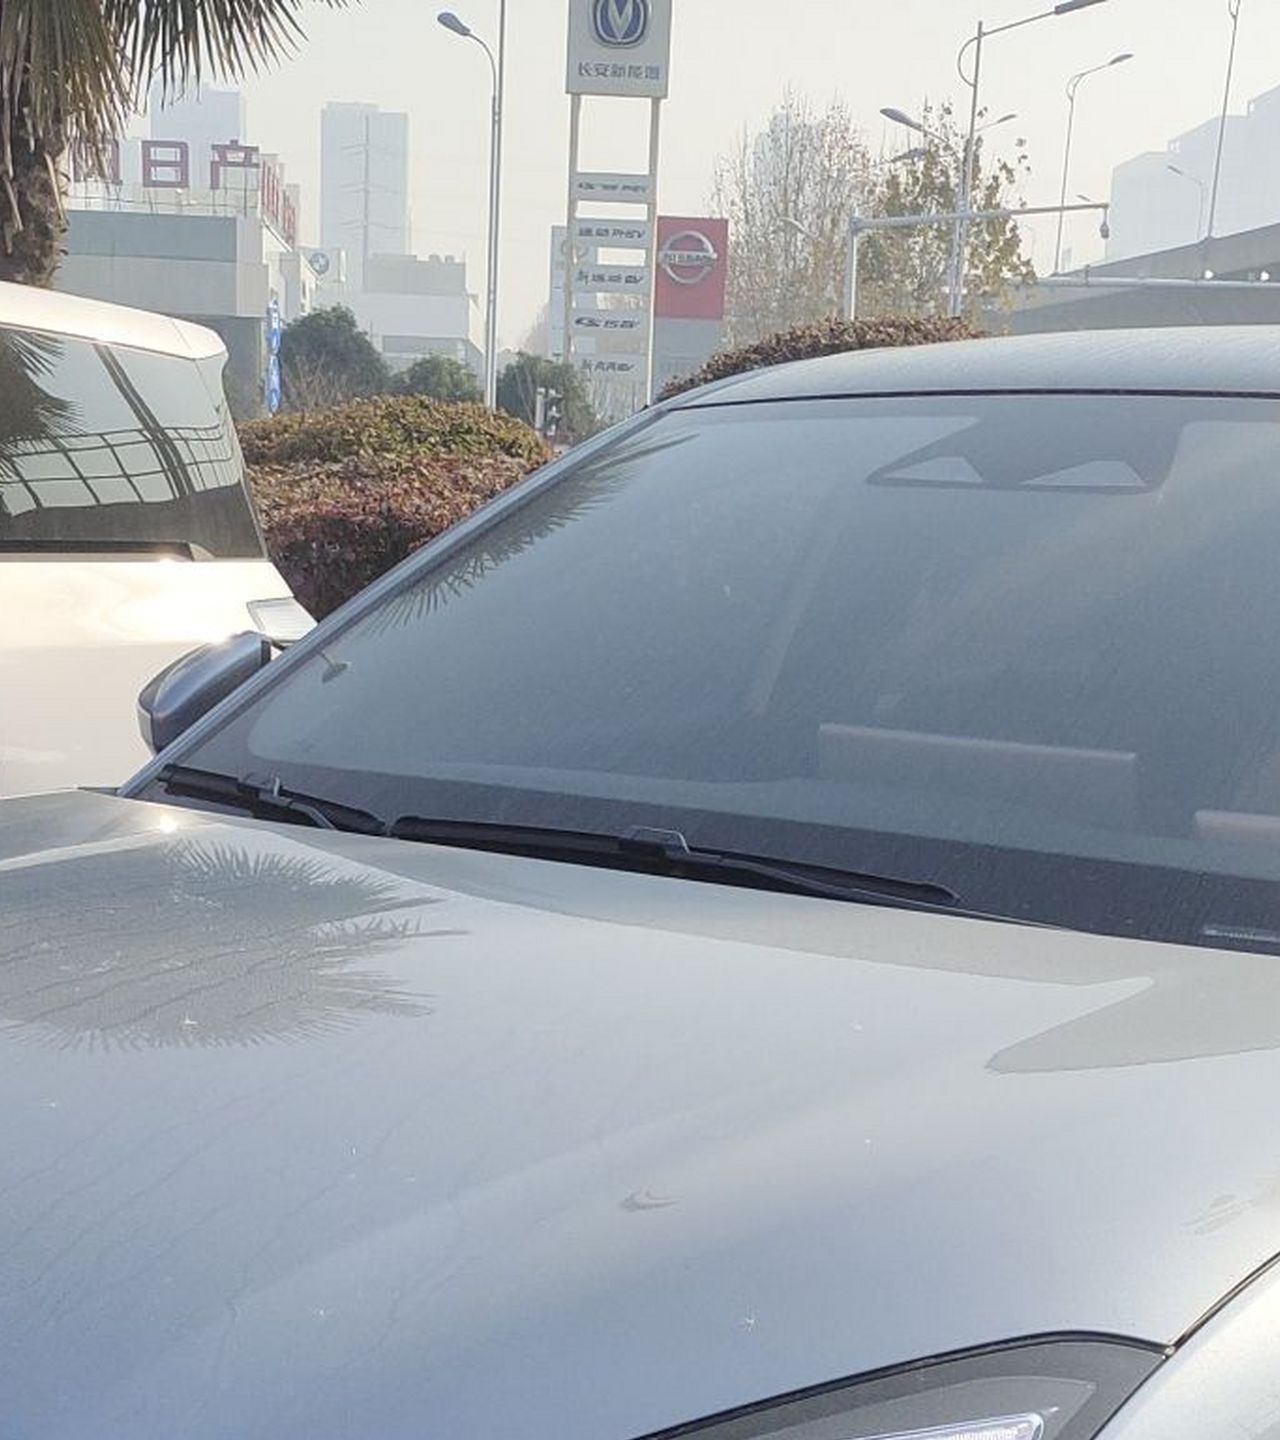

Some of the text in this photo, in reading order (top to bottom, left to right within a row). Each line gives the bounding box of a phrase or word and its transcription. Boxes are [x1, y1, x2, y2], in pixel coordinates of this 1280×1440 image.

[577, 62, 660, 80] 长安新能源
